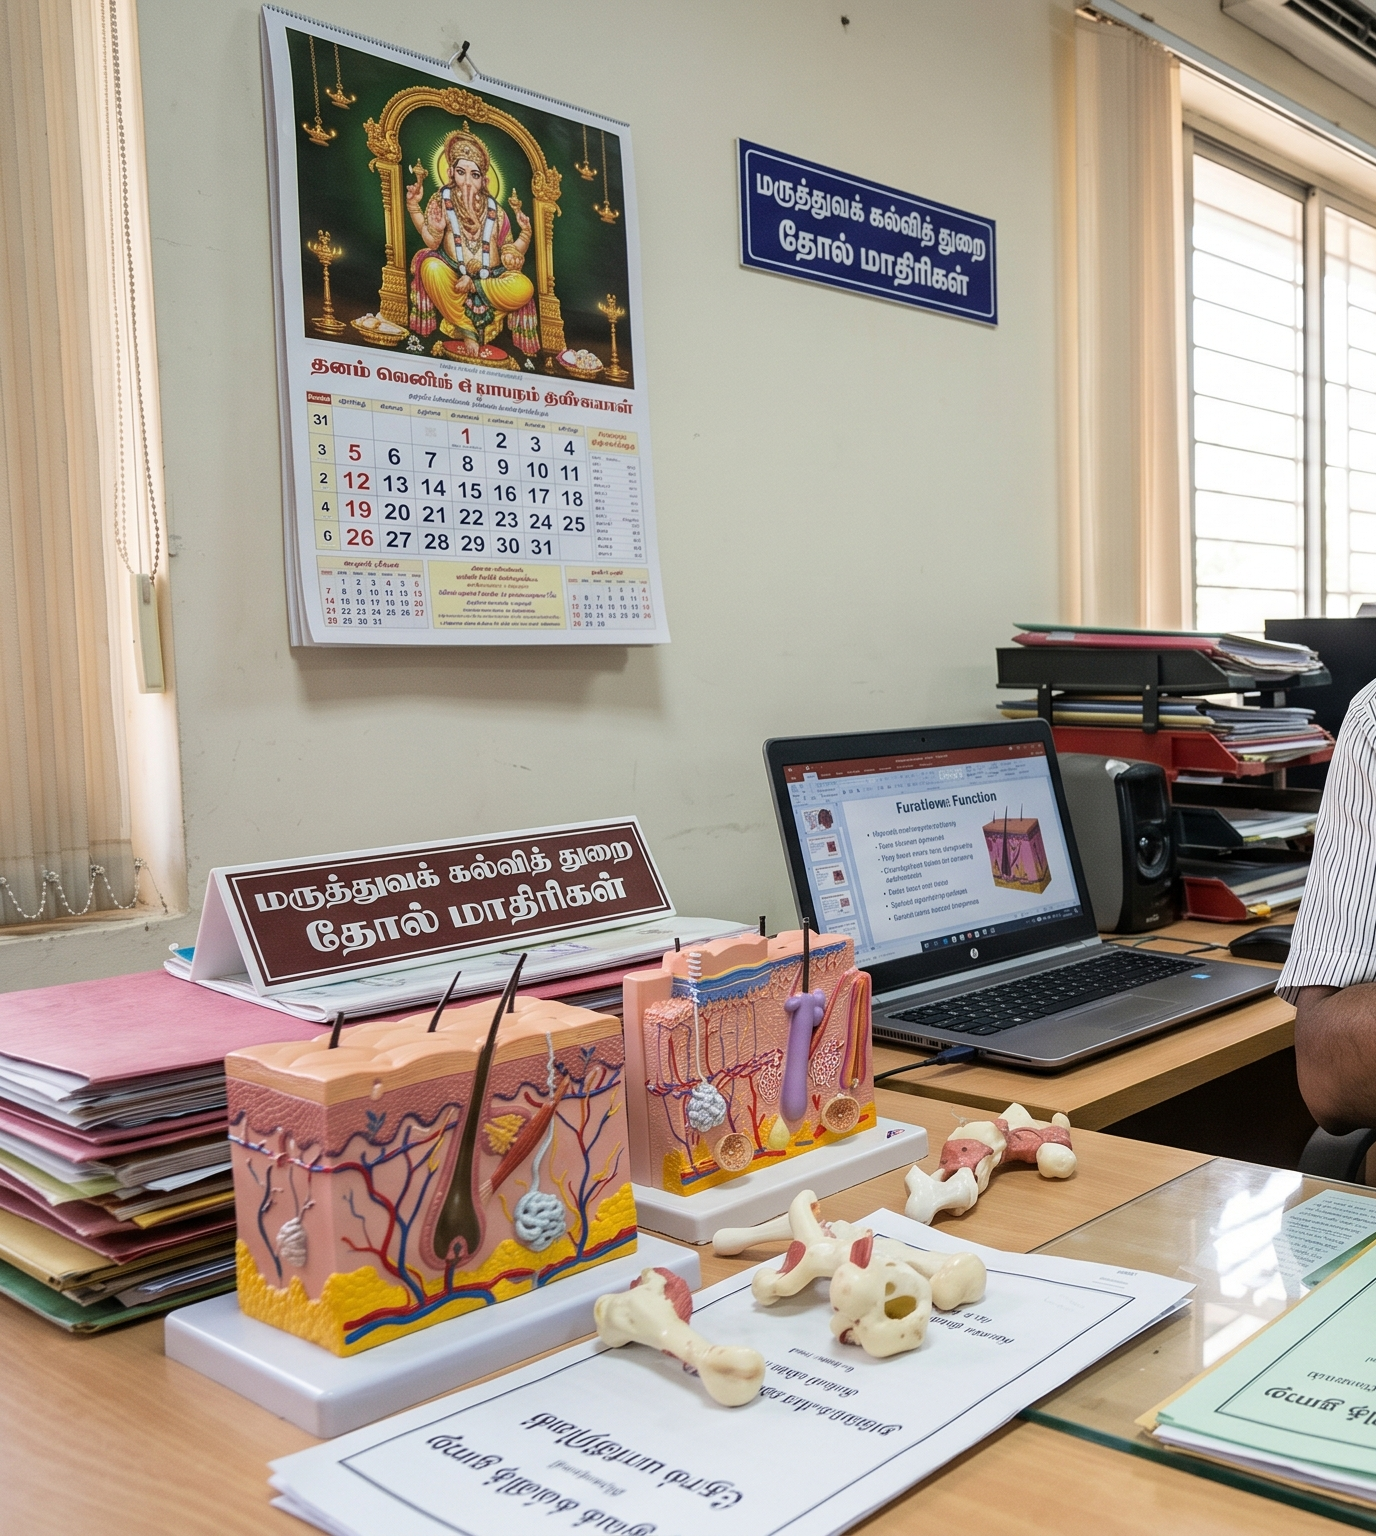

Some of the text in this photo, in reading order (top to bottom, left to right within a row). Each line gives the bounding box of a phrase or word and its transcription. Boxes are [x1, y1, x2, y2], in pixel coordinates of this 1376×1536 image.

[756, 172, 986, 262] மருத்துவக் கல்வித் துறை
[778, 219, 969, 296] தோல் மாதிரிகள்
[314, 414, 575, 455] 31 1 2 3 4
[318, 444, 578, 481] 3 5 6 7 8 9 10 11
[320, 472, 583, 506] 2 12 13 14 15 16 17 18
[322, 500, 585, 532] 4 19 20 21 22 23 24 25
[324, 529, 551, 555] 6 26 27 28 29 30 31
[952, 792, 997, 806] Function
[254, 838, 634, 914] மருத்துவக் கல்வித் துறை
[306, 871, 628, 957] தோல் மாதிரிகள்
